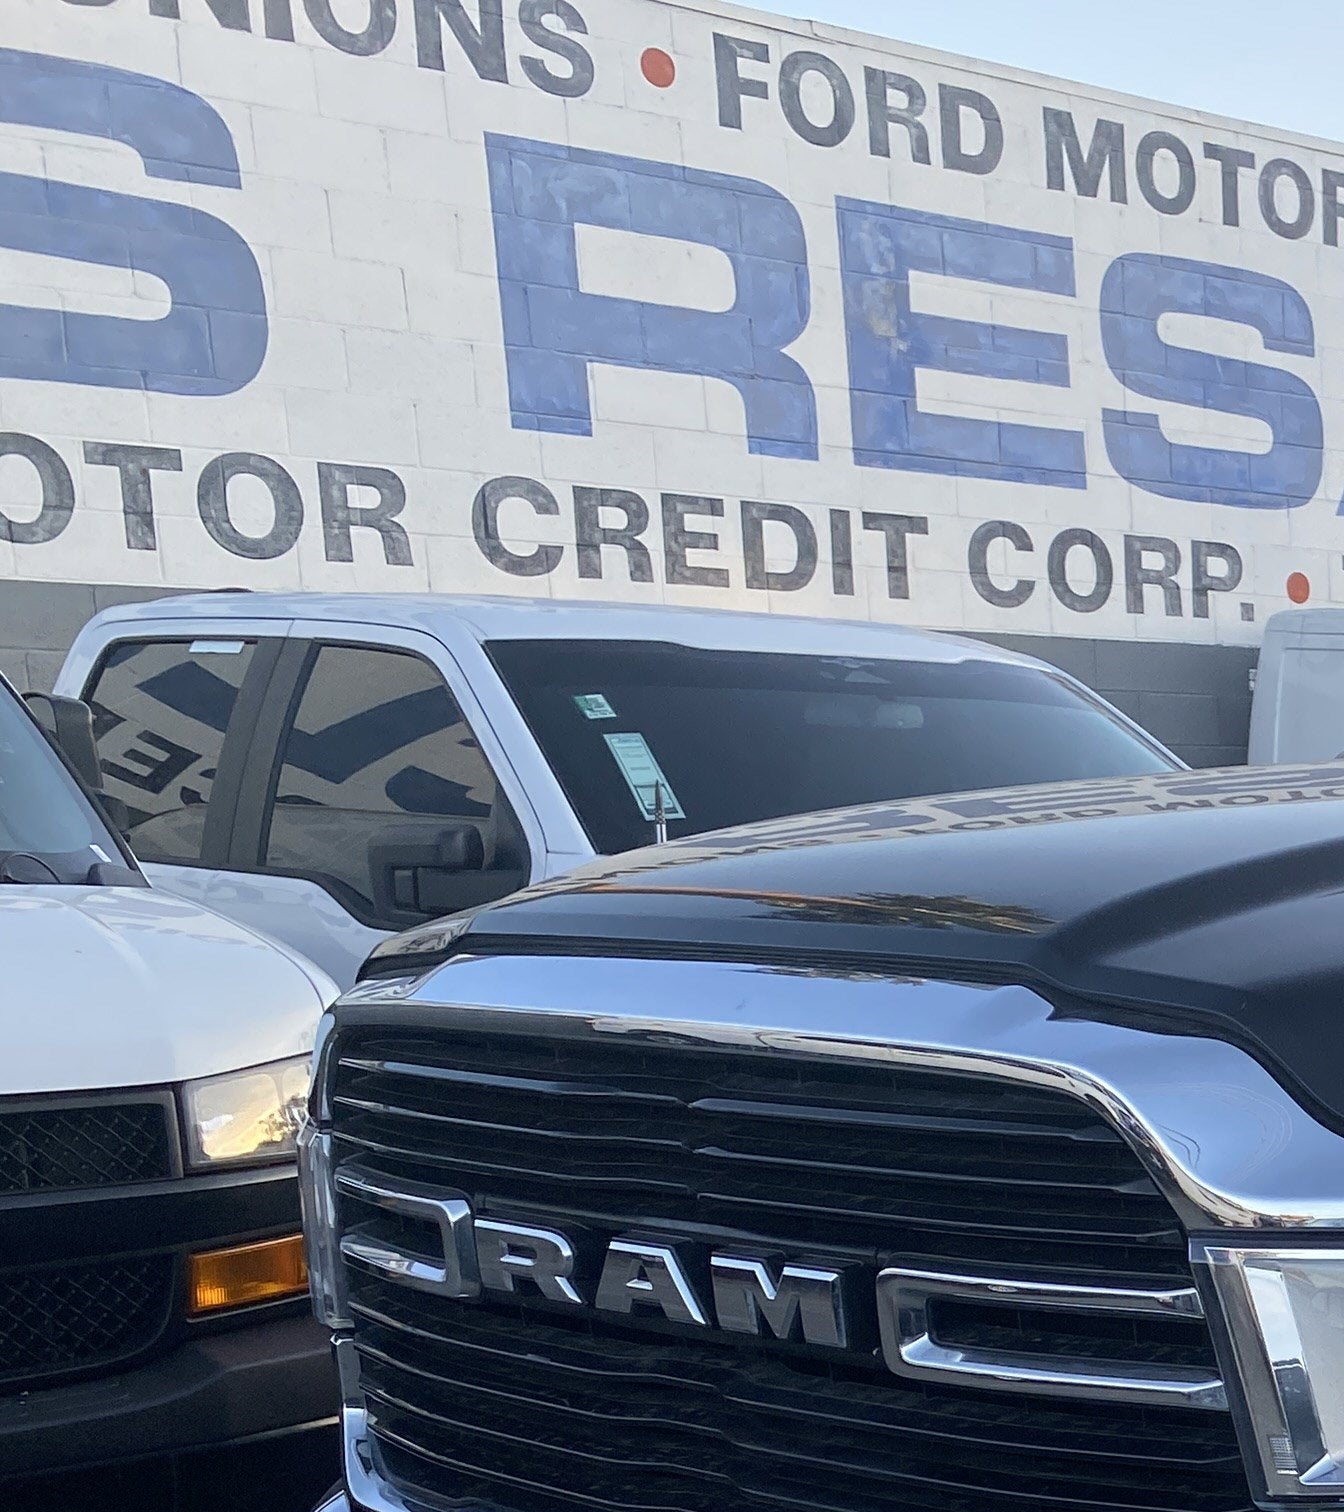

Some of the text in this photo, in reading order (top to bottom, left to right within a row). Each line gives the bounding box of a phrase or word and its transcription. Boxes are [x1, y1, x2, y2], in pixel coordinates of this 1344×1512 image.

[712, 32, 1004, 175] FORD
[471, 475, 928, 600] CREDIT
[967, 520, 1256, 623] CORP.
[474, 1218, 850, 1348] RAM
